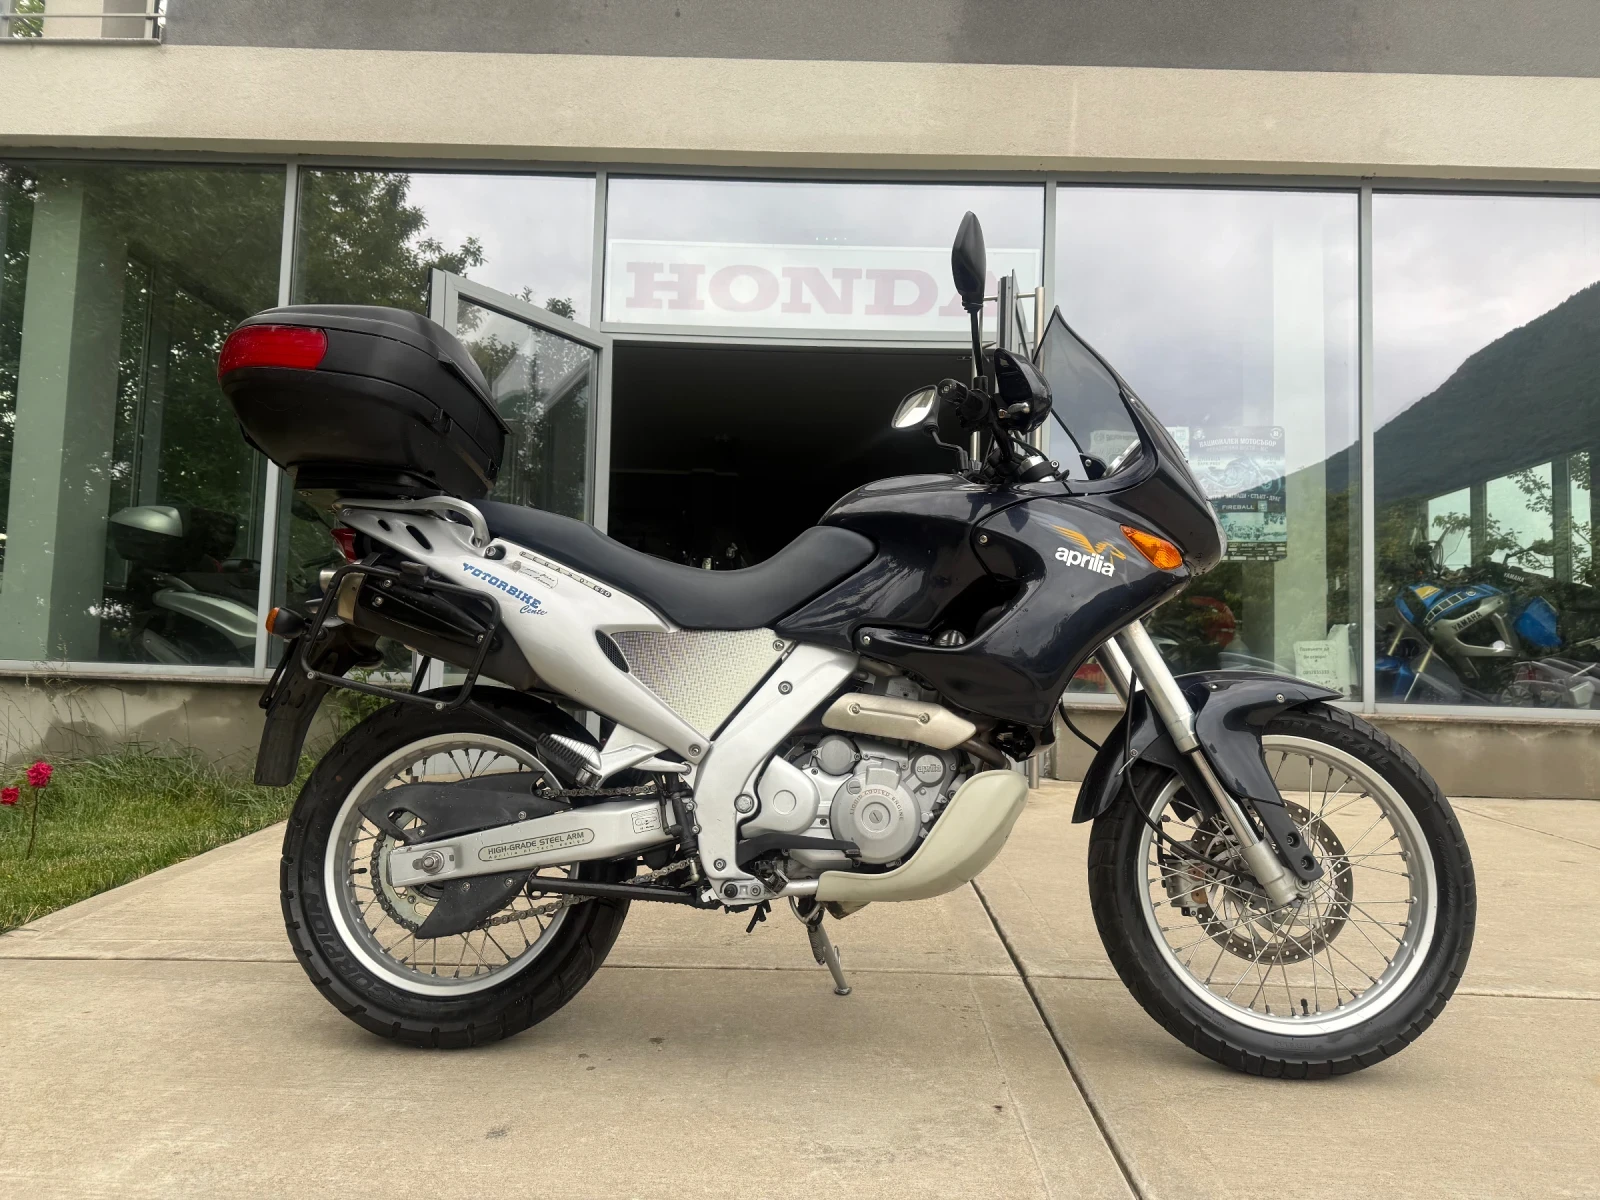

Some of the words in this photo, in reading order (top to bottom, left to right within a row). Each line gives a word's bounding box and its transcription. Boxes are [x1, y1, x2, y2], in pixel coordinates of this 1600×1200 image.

[1199, 438, 1239, 448] НАЦИОНАЛЕН
[1240, 437, 1277, 447] МОТОСЪБОР
[1054, 546, 1116, 577] aprilia
[1503, 572, 1525, 583] YAMAHA
[1451, 611, 1483, 632] YAMAHA
[916, 764, 943, 775] aprilia
[487, 840, 537, 856] HIGH-GRADE
[538, 835, 565, 847] STEEL
[566, 831, 585, 841] ARM
